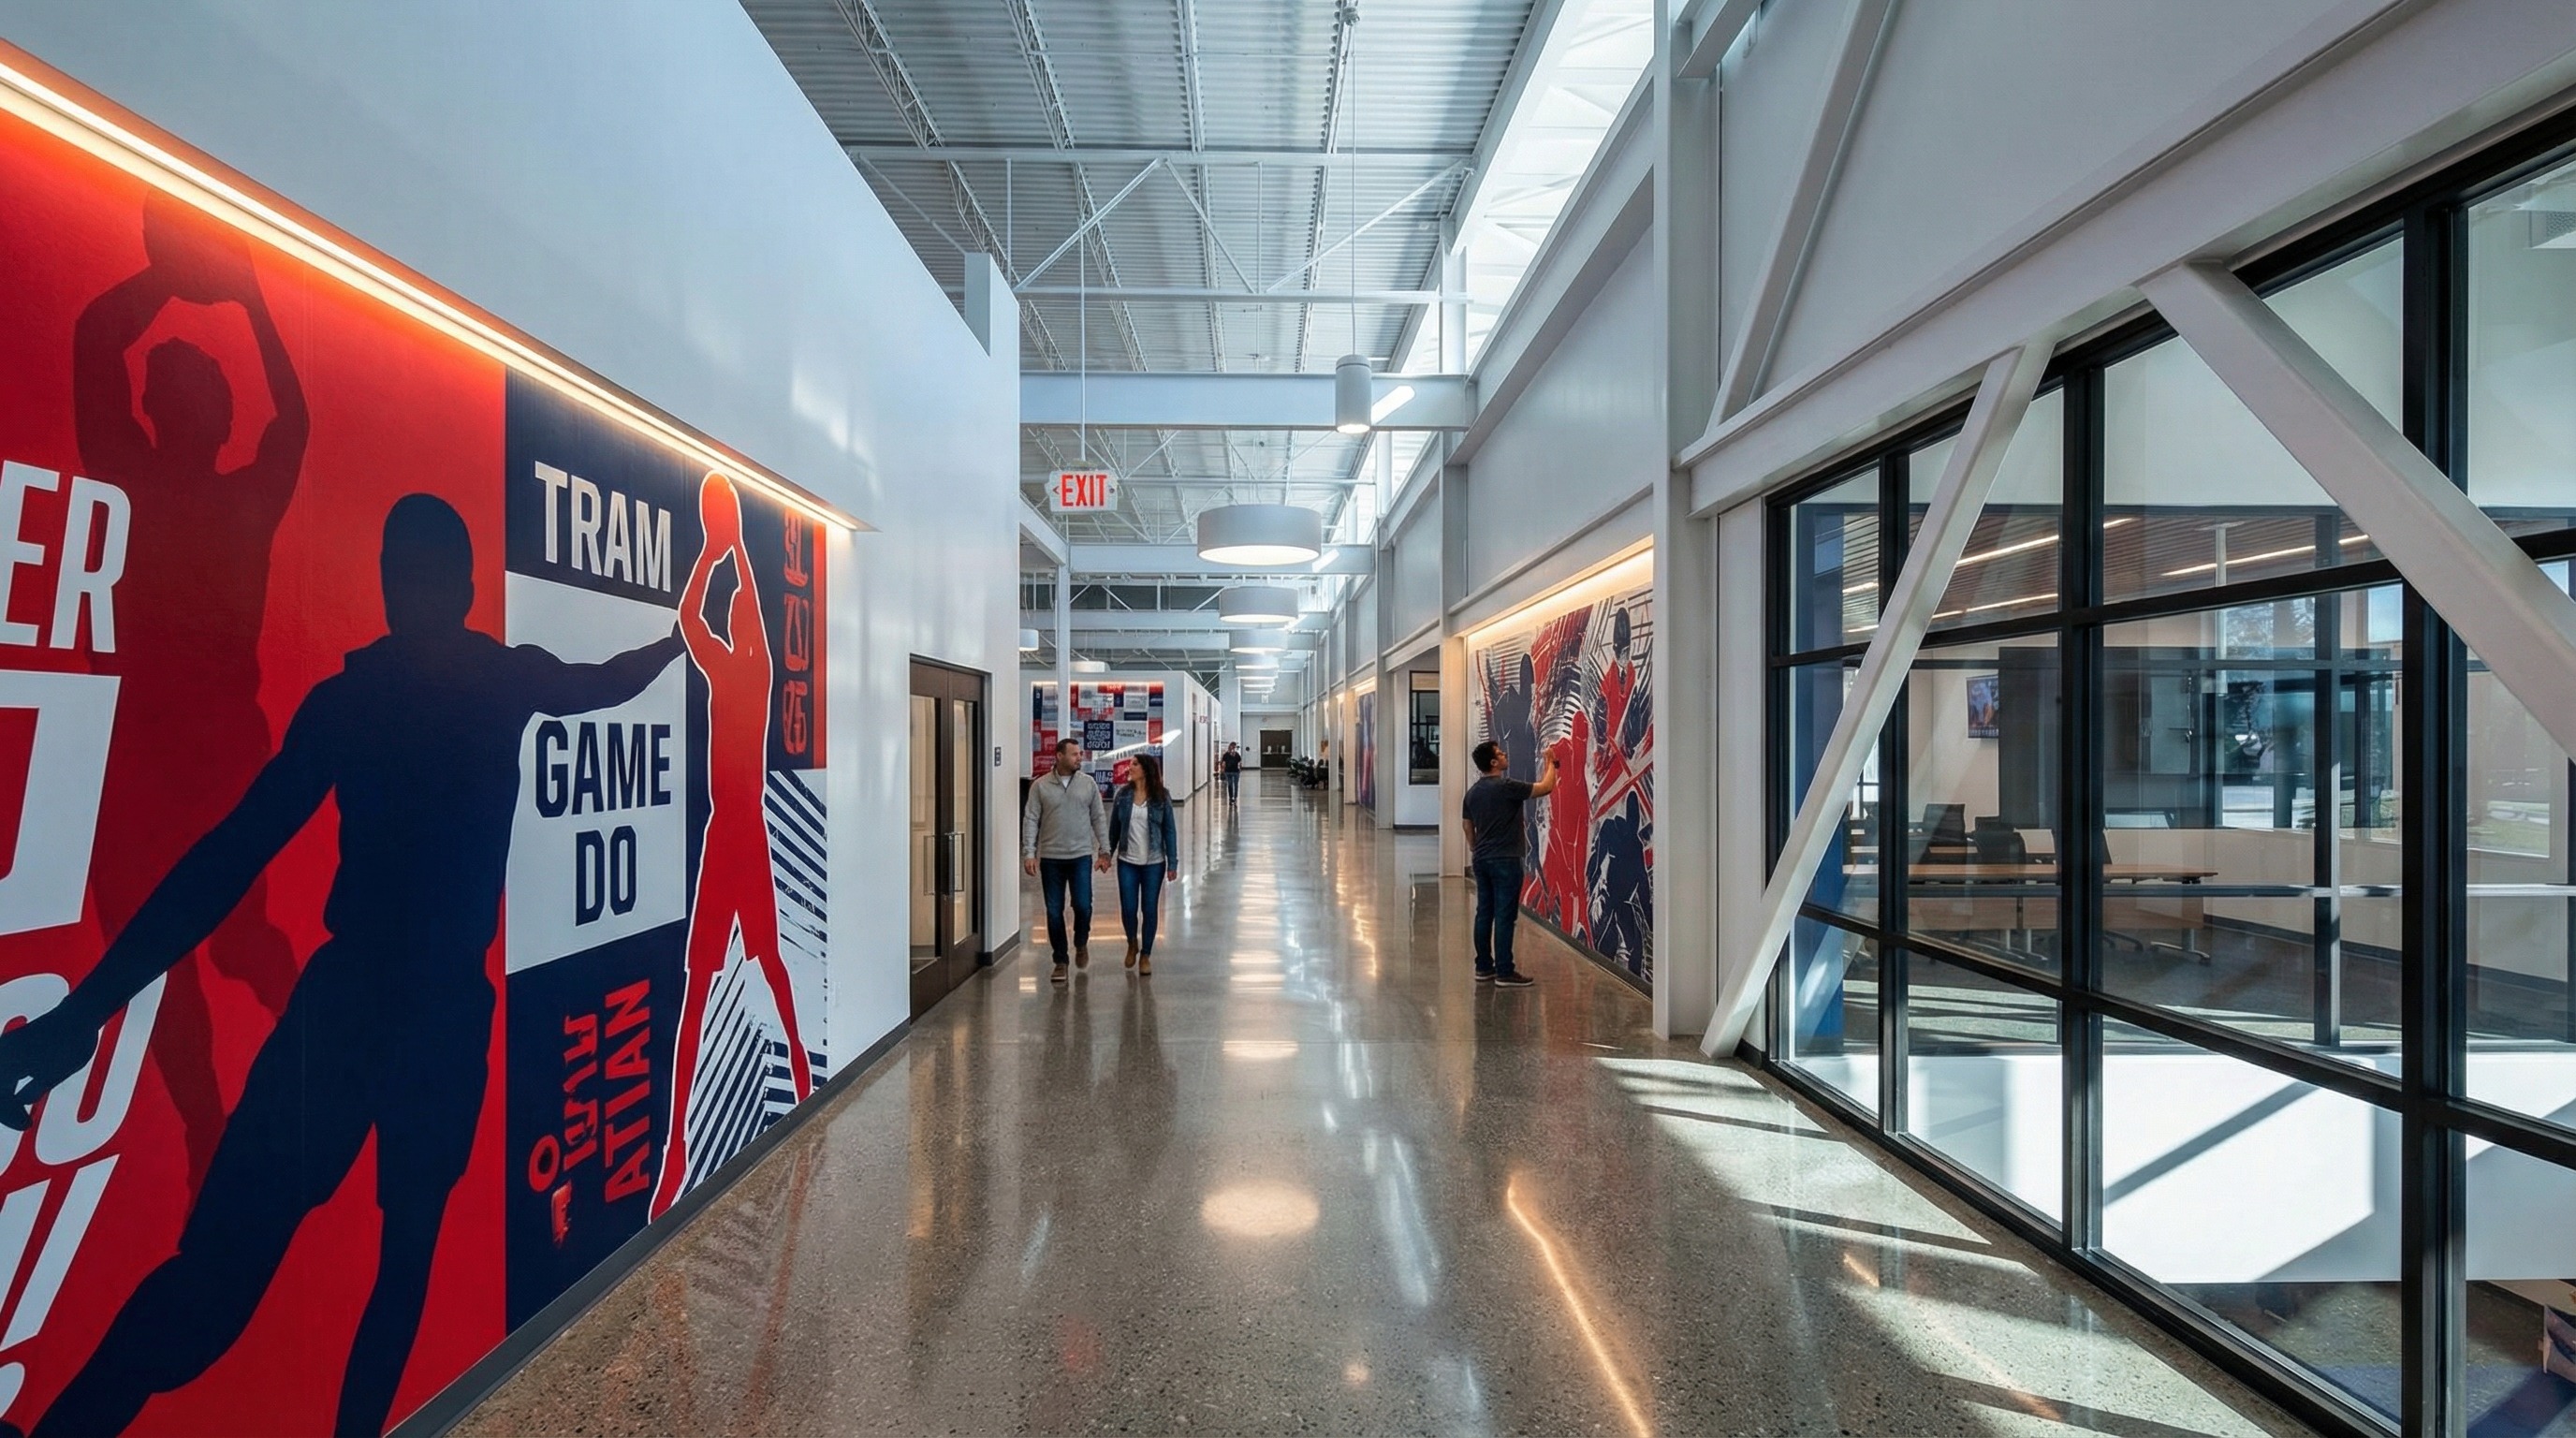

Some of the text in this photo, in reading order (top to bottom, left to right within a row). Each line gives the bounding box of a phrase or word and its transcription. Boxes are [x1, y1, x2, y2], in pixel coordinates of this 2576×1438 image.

[534, 460, 671, 593] TRAM
[1061, 474, 1107, 506] EXIT
[535, 720, 671, 818] GAME
[576, 825, 637, 926] DO
